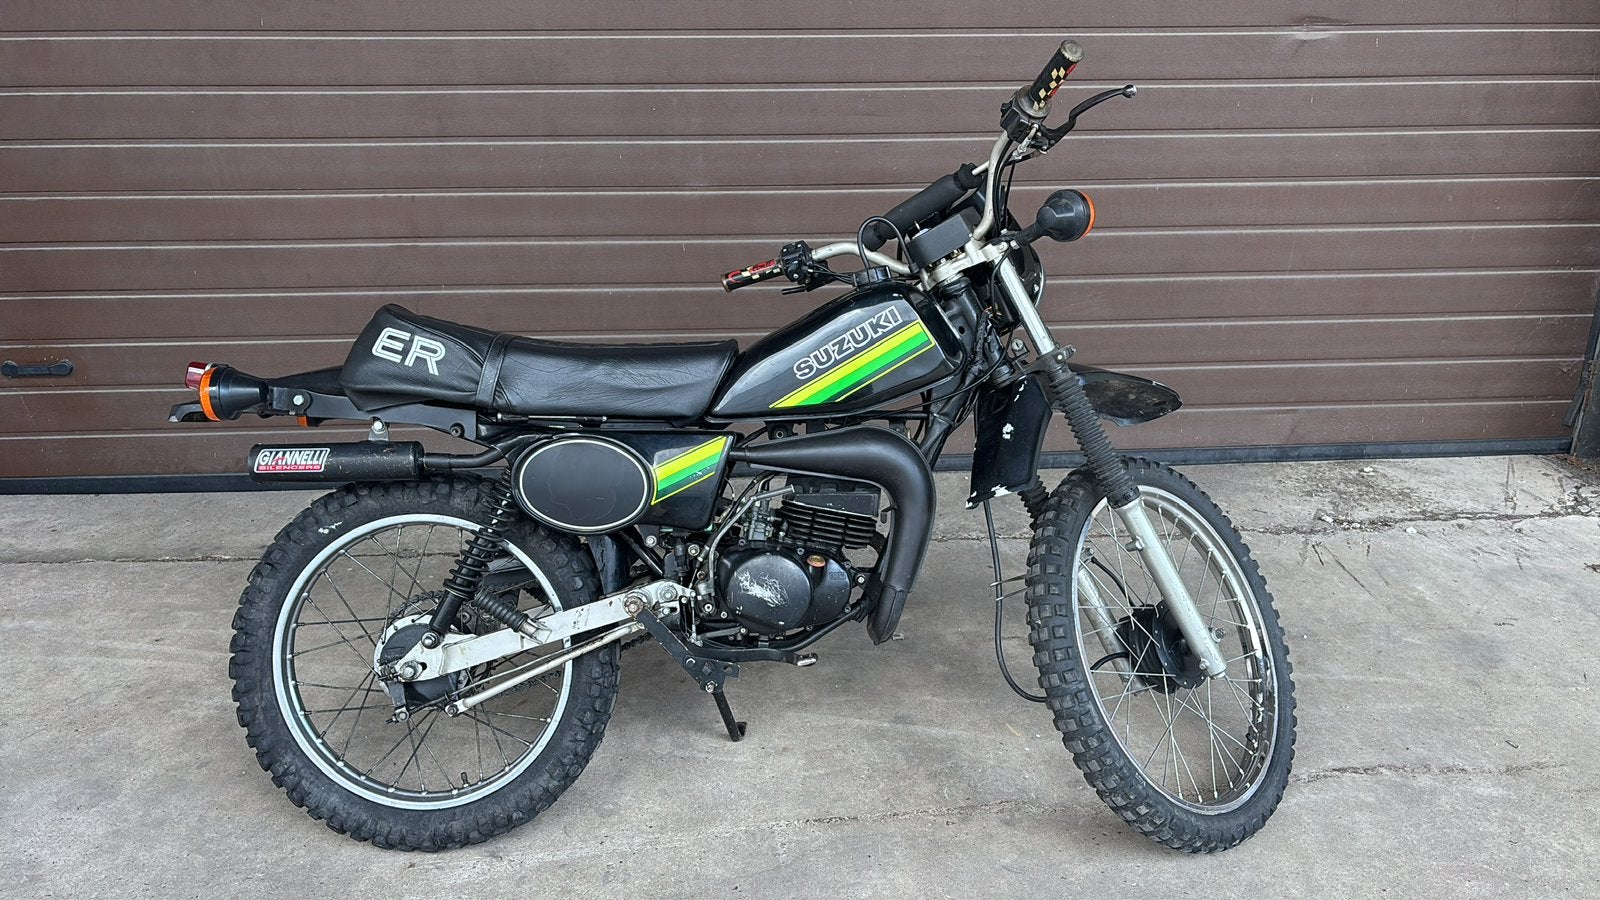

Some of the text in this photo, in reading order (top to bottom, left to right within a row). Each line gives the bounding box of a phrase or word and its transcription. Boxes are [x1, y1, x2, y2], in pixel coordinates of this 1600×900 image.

[371, 326, 446, 376] ER
[793, 305, 903, 379] SUZUKI
[259, 450, 327, 466] GIANNELLI
